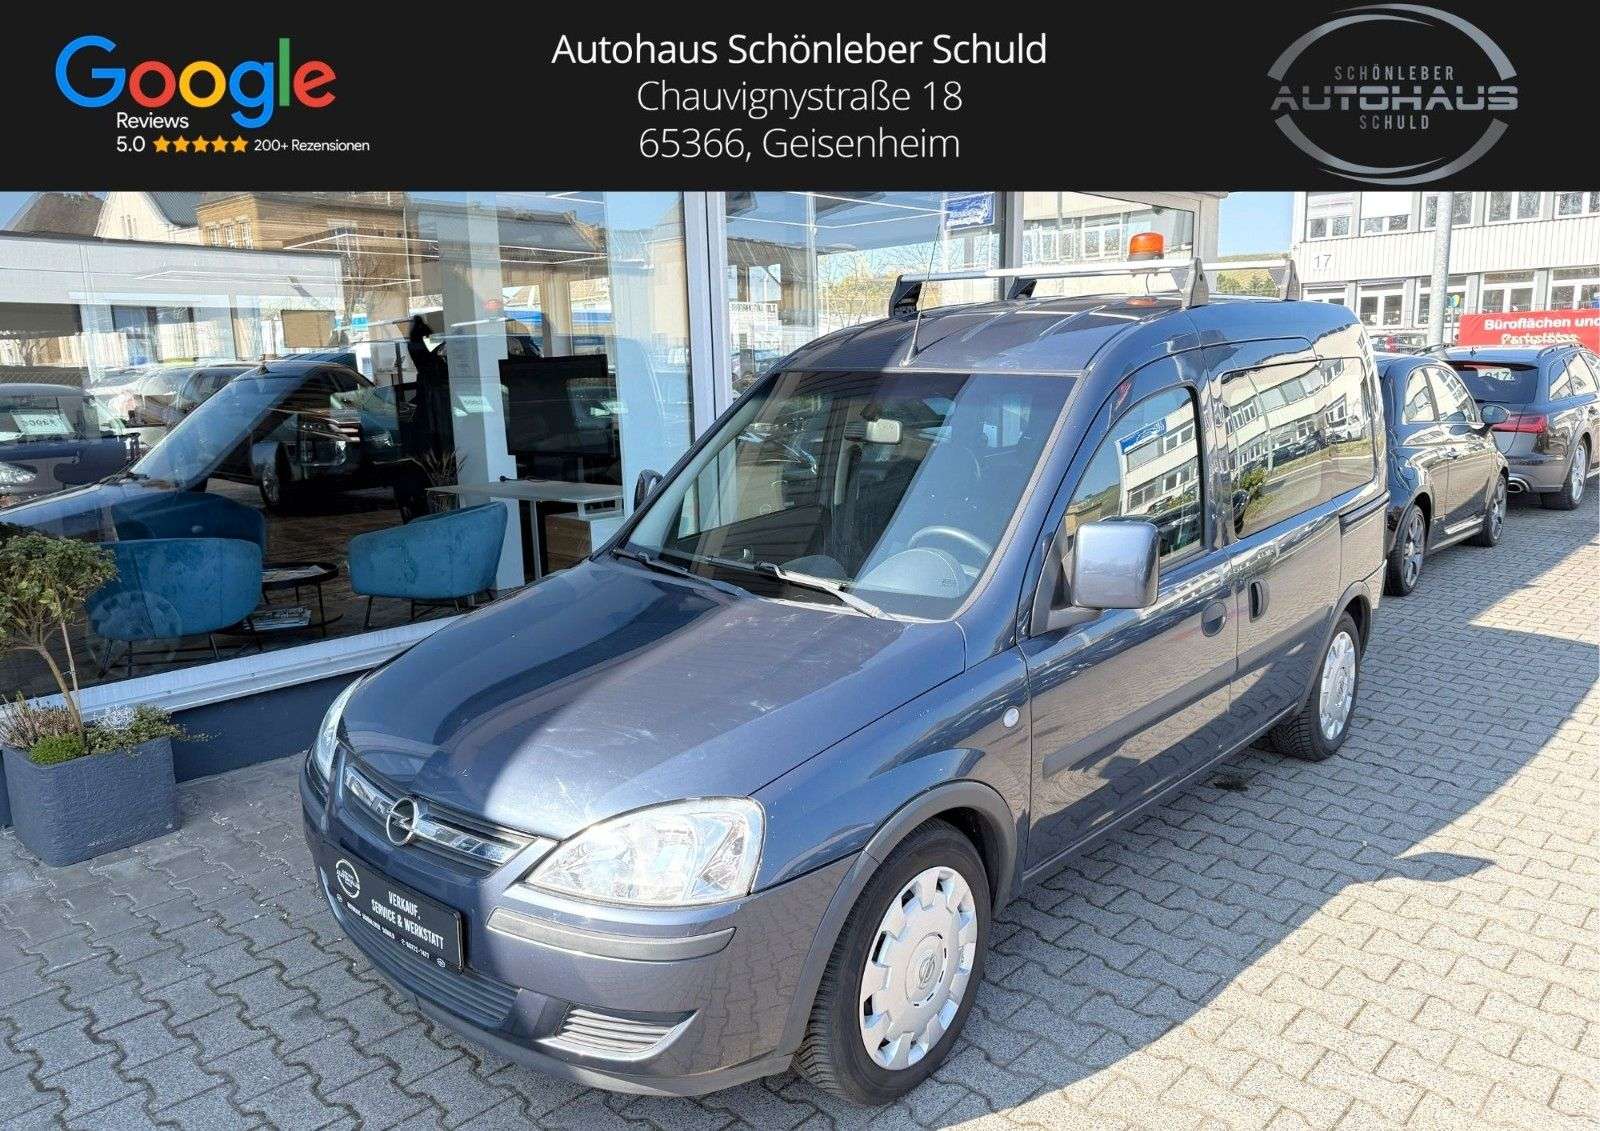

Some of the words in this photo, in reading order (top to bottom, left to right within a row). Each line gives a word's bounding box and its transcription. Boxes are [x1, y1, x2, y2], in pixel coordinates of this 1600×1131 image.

[1313, 254, 1333, 269] 17
[1483, 317, 1572, 331] Büroflächen
[371, 899, 397, 925] SERVICE
[403, 917, 444, 950] WERKSTATT
